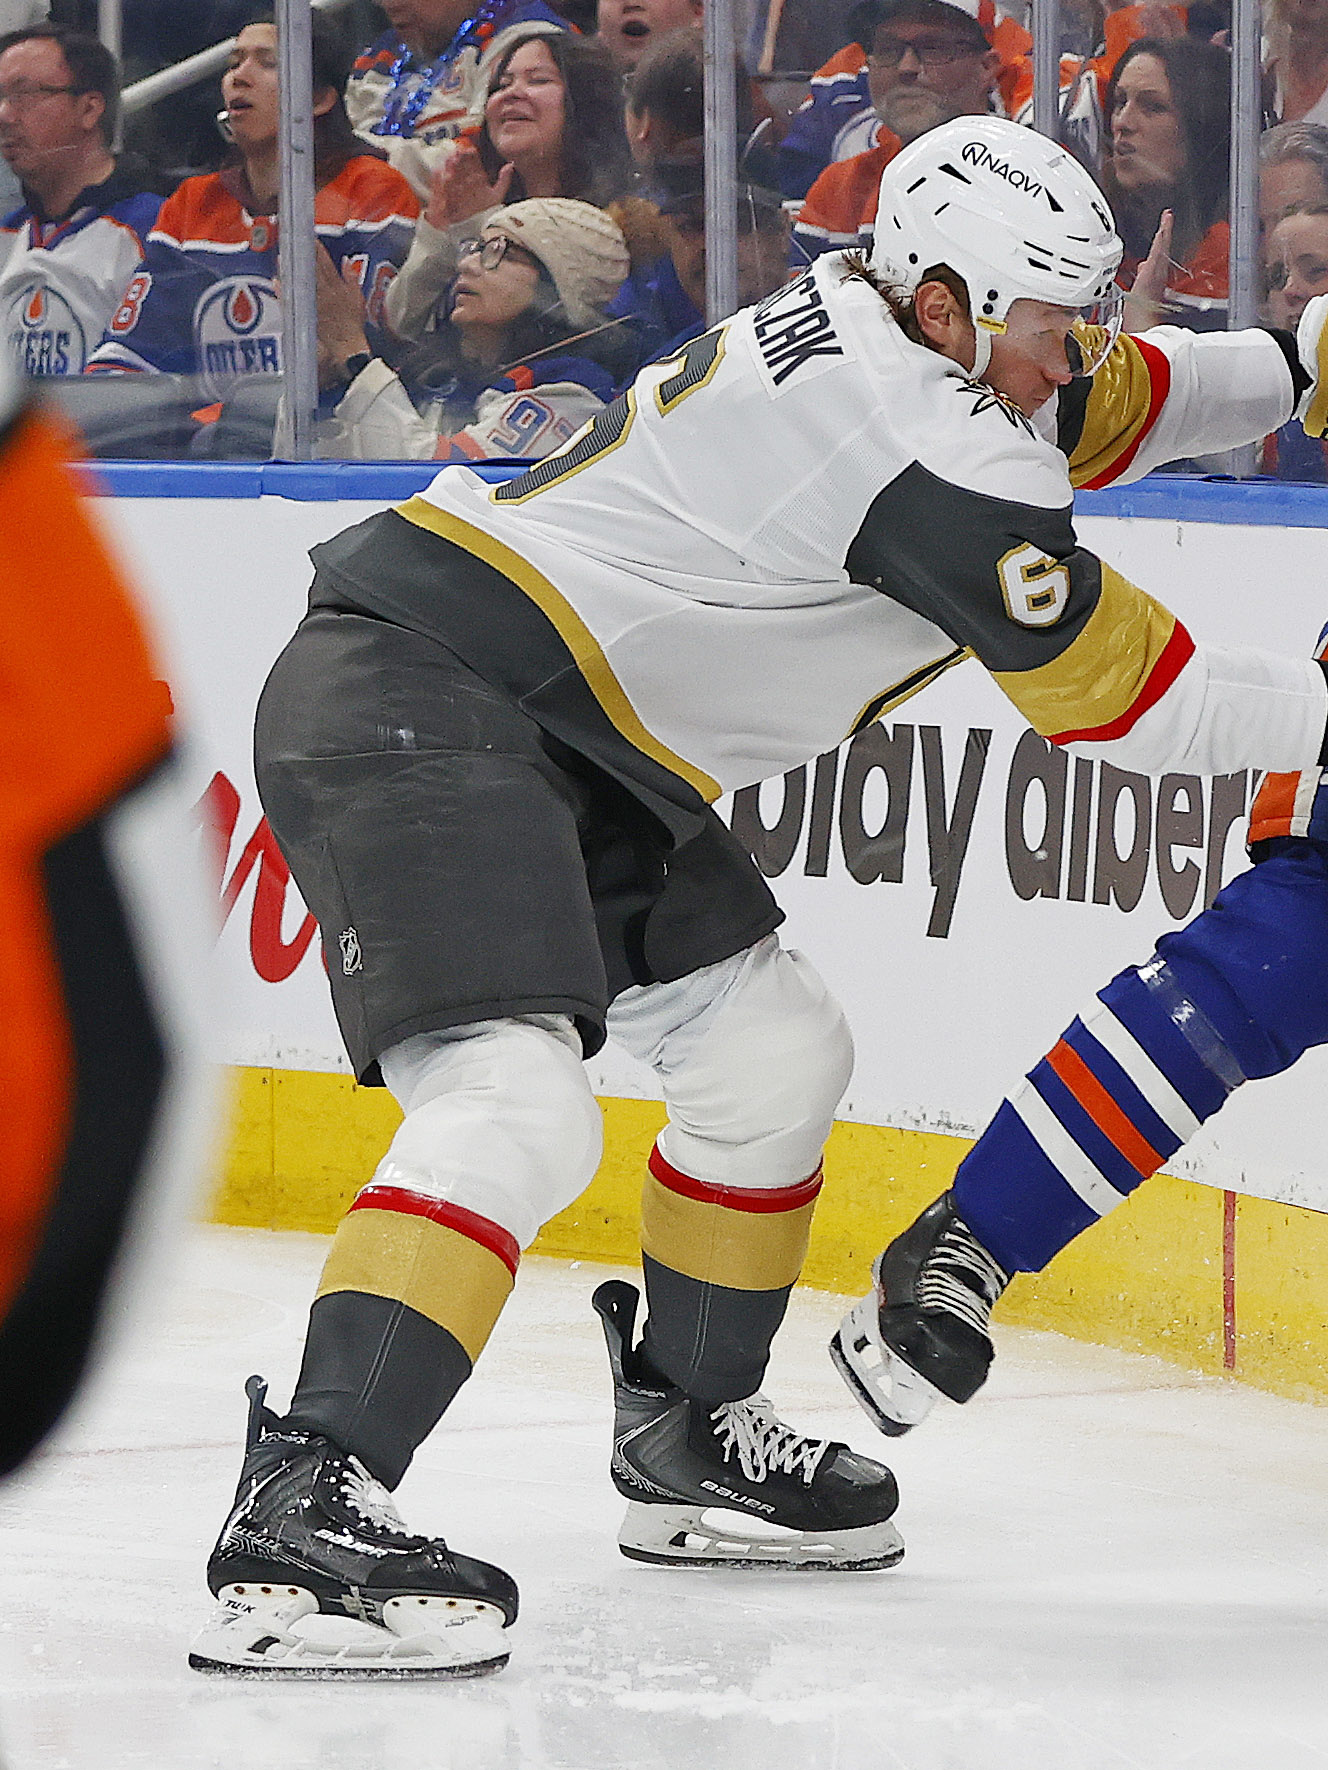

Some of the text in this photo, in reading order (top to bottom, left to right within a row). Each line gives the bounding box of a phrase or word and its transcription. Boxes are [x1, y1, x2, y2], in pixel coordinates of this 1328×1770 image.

[980, 153, 1043, 198] NAQVI
[752, 275, 844, 386] CZAK
[995, 541, 1071, 629] 6
[1005, 727, 1263, 921] alber
[700, 1479, 777, 1515] BAUER
